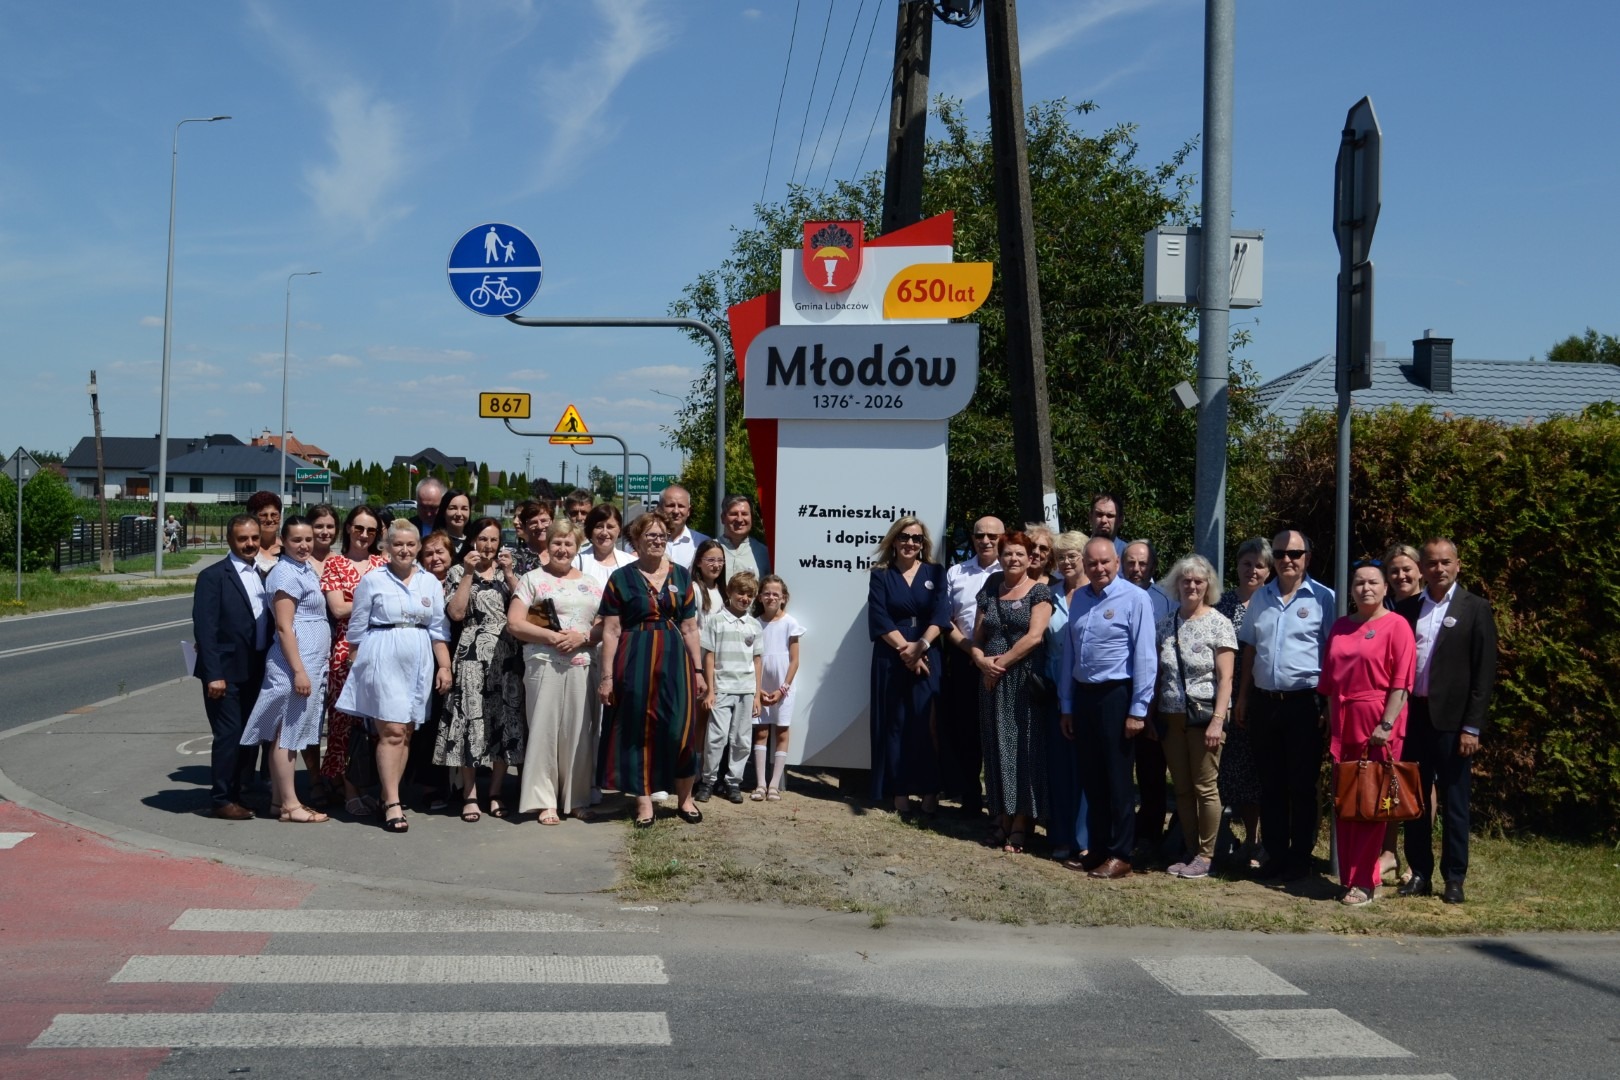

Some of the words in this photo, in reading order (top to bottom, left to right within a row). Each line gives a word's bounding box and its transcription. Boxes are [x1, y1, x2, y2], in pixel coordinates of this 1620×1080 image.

[897, 279, 946, 303] 650
[948, 284, 975, 302] lat
[794, 302, 823, 311] Gmina
[825, 301, 869, 310] Lubaczów
[766, 343, 956, 387] Młodów
[490, 397, 522, 413] 867
[864, 394, 903, 409] 2026
[618, 475, 665, 483] Hyniec-drój
[798, 504, 896, 522] #Zamieszkaj
[826, 530, 831, 543] i
[799, 554, 852, 572] własną
